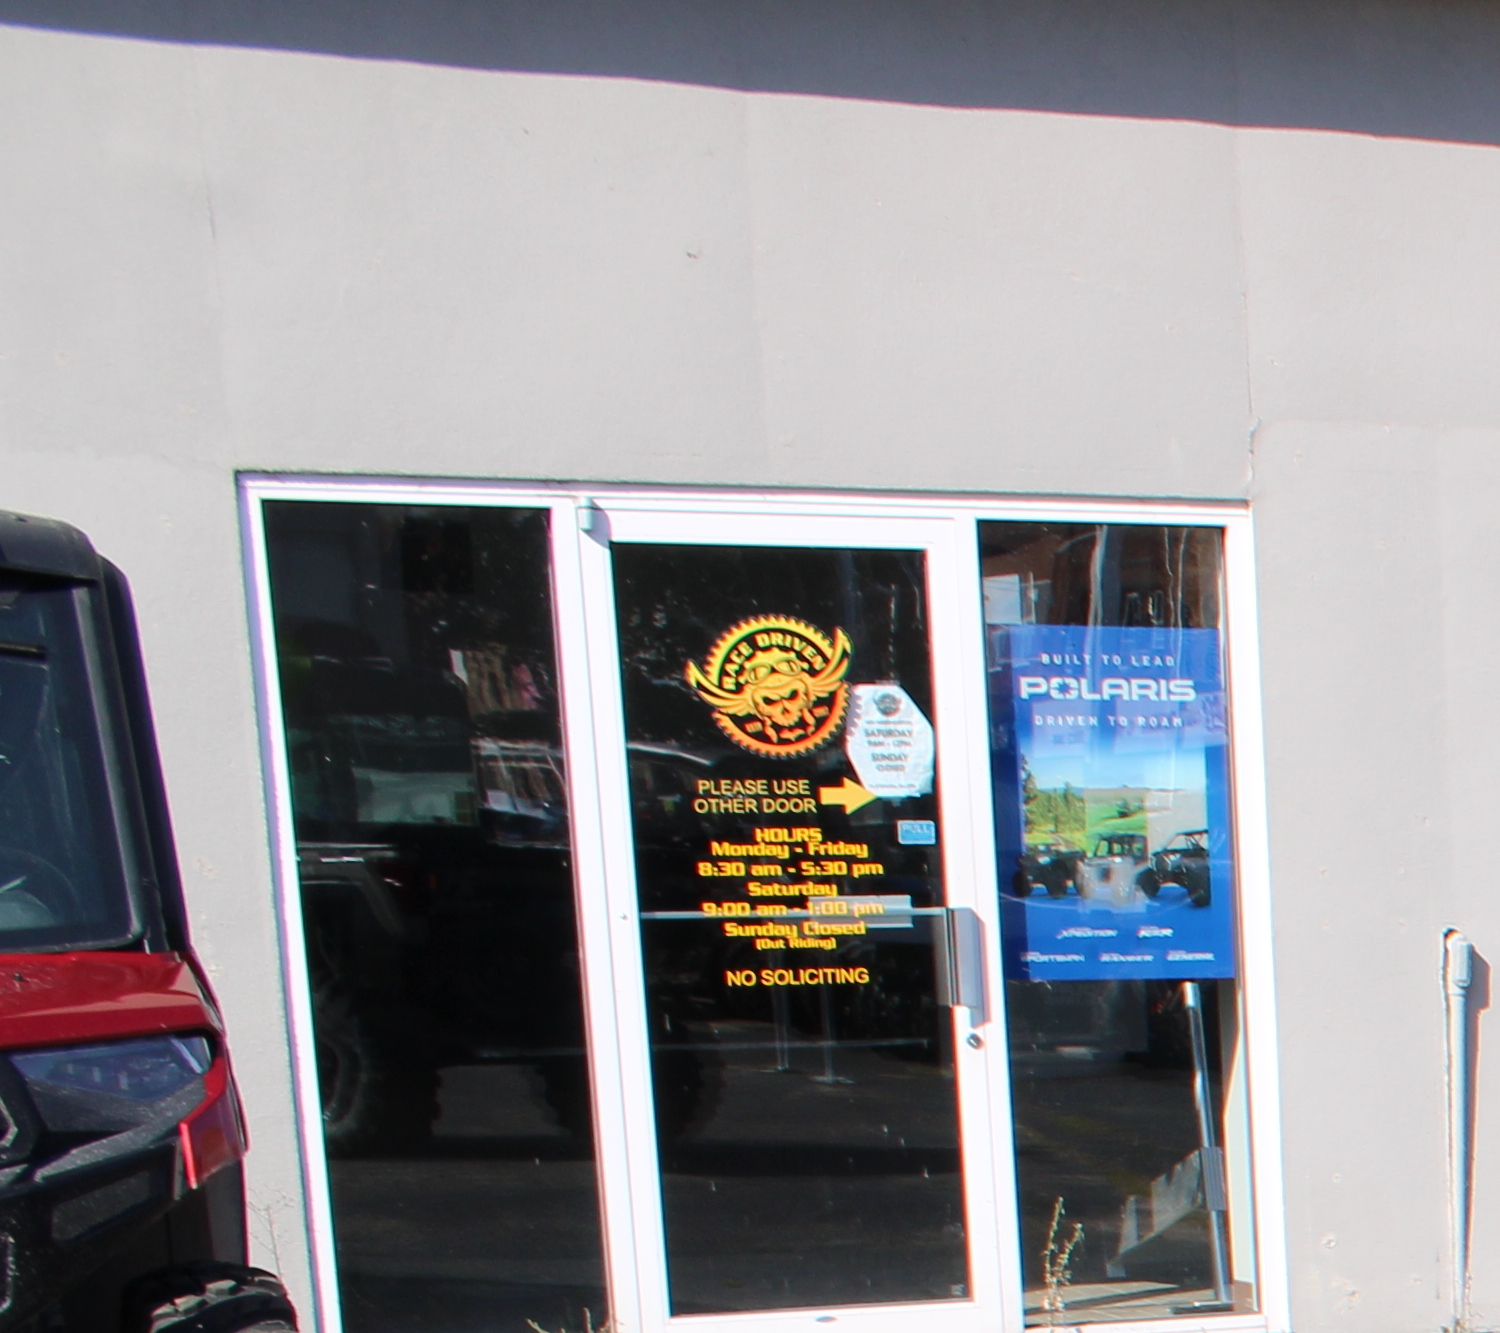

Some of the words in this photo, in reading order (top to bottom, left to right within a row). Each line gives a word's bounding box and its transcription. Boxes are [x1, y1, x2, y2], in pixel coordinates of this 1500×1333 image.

[721, 641, 754, 691] RACE
[754, 631, 827, 671] DRIVEN
[1040, 653, 1092, 667] BUILT
[1101, 654, 1122, 666] TO
[1131, 655, 1176, 667] LEAD
[1019, 676, 1197, 701] POLARIS
[1034, 715, 1099, 727] DRIVEN
[1108, 716, 1128, 727] TO
[1138, 716, 1183, 728] ROAM
[864, 728, 913, 738] SATURDAY
[871, 752, 909, 762] SUNDAY
[698, 779, 769, 795] PLEASE
[773, 779, 811, 795] USE
[694, 798, 759, 814] OTHER
[763, 798, 818, 814] DOOR
[755, 827, 822, 843] HOURS
[711, 841, 790, 859] Monday
[807, 841, 869, 859] Friday
[698, 862, 746, 876] 8:30
[751, 864, 782, 876] am
[801, 861, 848, 876] 5:30
[853, 863, 884, 878] pm
[748, 881, 838, 897] Saturday
[702, 902, 750, 917] 9:00
[756, 904, 788, 916] am
[807, 901, 848, 916] 1:00
[853, 903, 885, 918] pm
[724, 922, 798, 938] Sunday
[803, 921, 866, 935] Closed
[755, 938, 786, 950] (Out
[789, 937, 837, 950] Riding)
[726, 970, 757, 987] NO
[761, 967, 870, 986] SOLICITING
